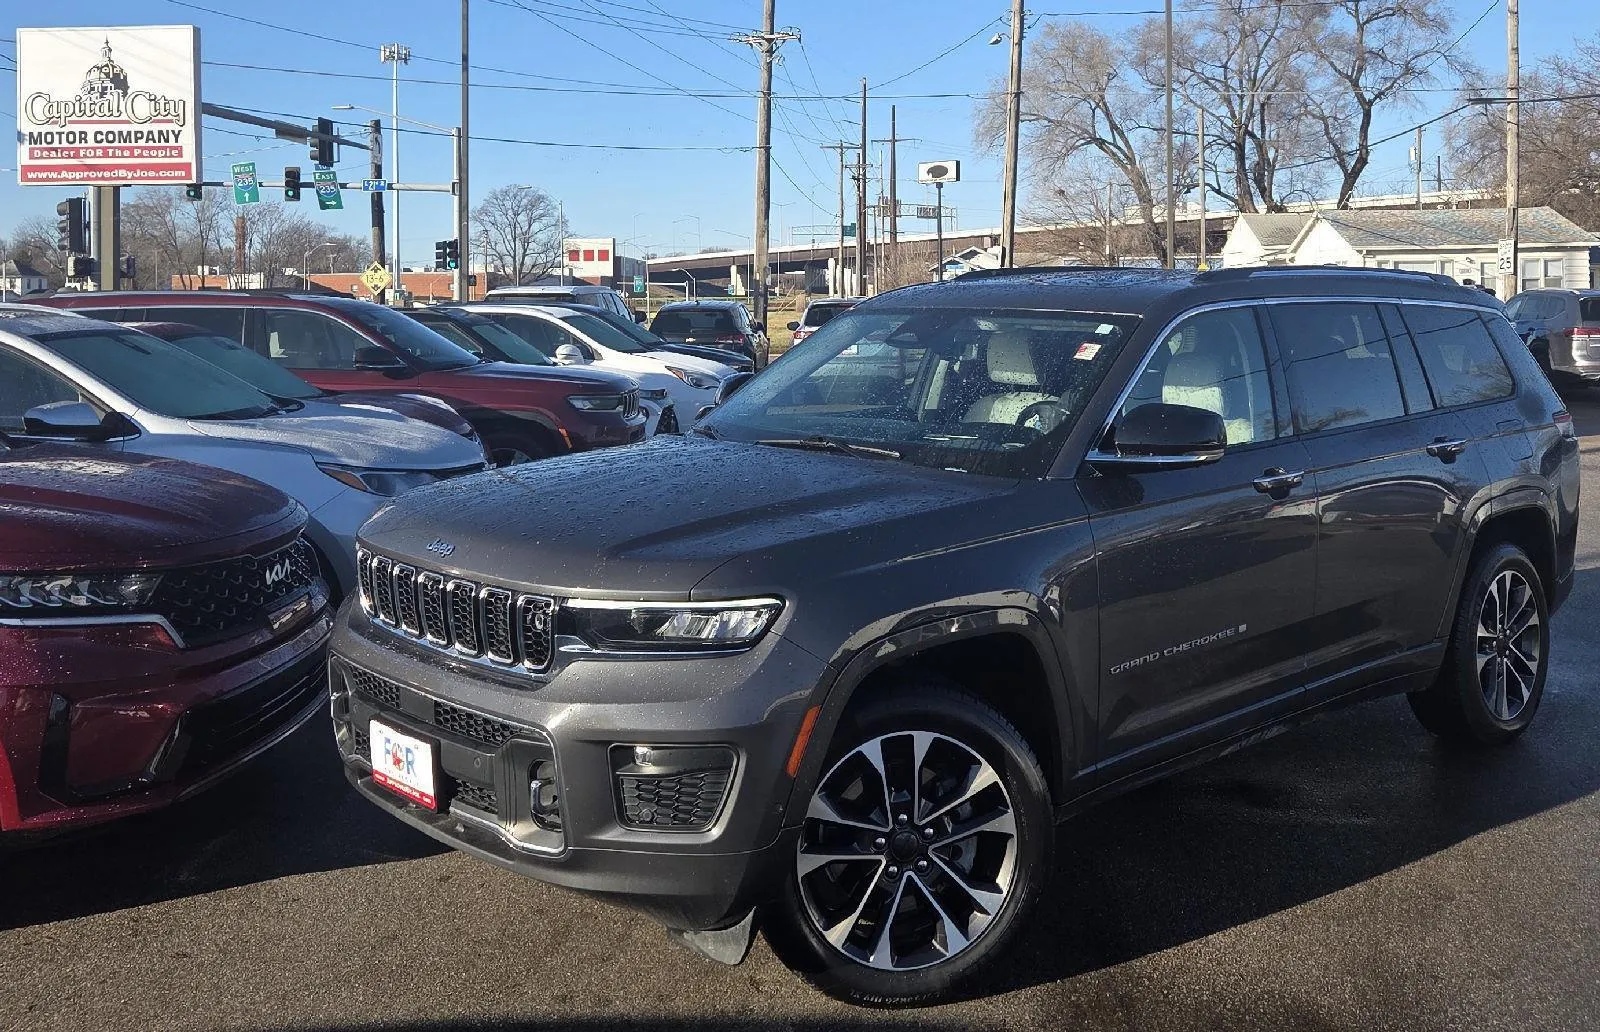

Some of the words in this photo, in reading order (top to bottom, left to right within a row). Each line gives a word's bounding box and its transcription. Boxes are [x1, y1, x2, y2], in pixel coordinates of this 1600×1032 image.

[25, 91, 122, 128] Capital
[125, 90, 186, 128] City
[28, 131, 88, 145] MOTOR
[94, 130, 182, 144] COMPANY
[79, 148, 104, 158] FOR
[106, 148, 131, 157] The
[27, 169, 186, 180] www.ApprovedByJoe.com
[237, 178, 254, 187] 235
[1500, 257, 1511, 269] 25
[426, 538, 455, 558] Jeep
[1110, 651, 1160, 674] GRAND
[1163, 627, 1236, 656] CHEROKEE
